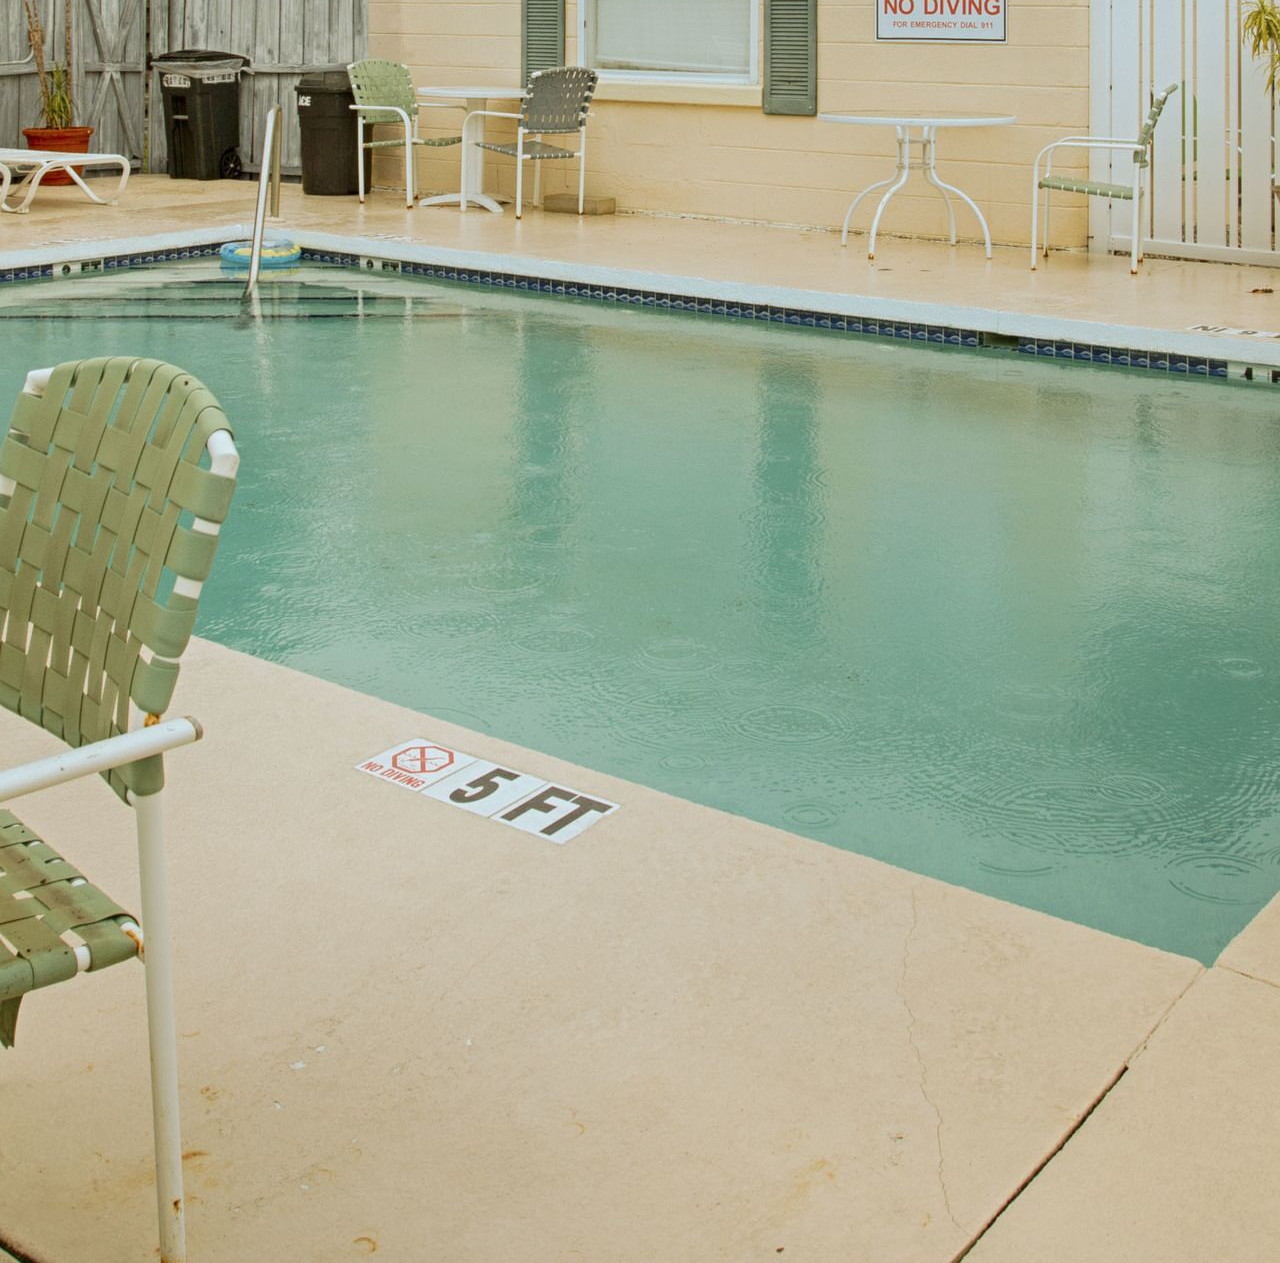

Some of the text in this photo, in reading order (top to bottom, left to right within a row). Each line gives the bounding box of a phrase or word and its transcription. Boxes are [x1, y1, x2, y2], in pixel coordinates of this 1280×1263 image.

[910, 21, 957, 29] EMERGENCY
[361, 761, 426, 789] NO DIVING
[449, 768, 614, 836] 5 FT
